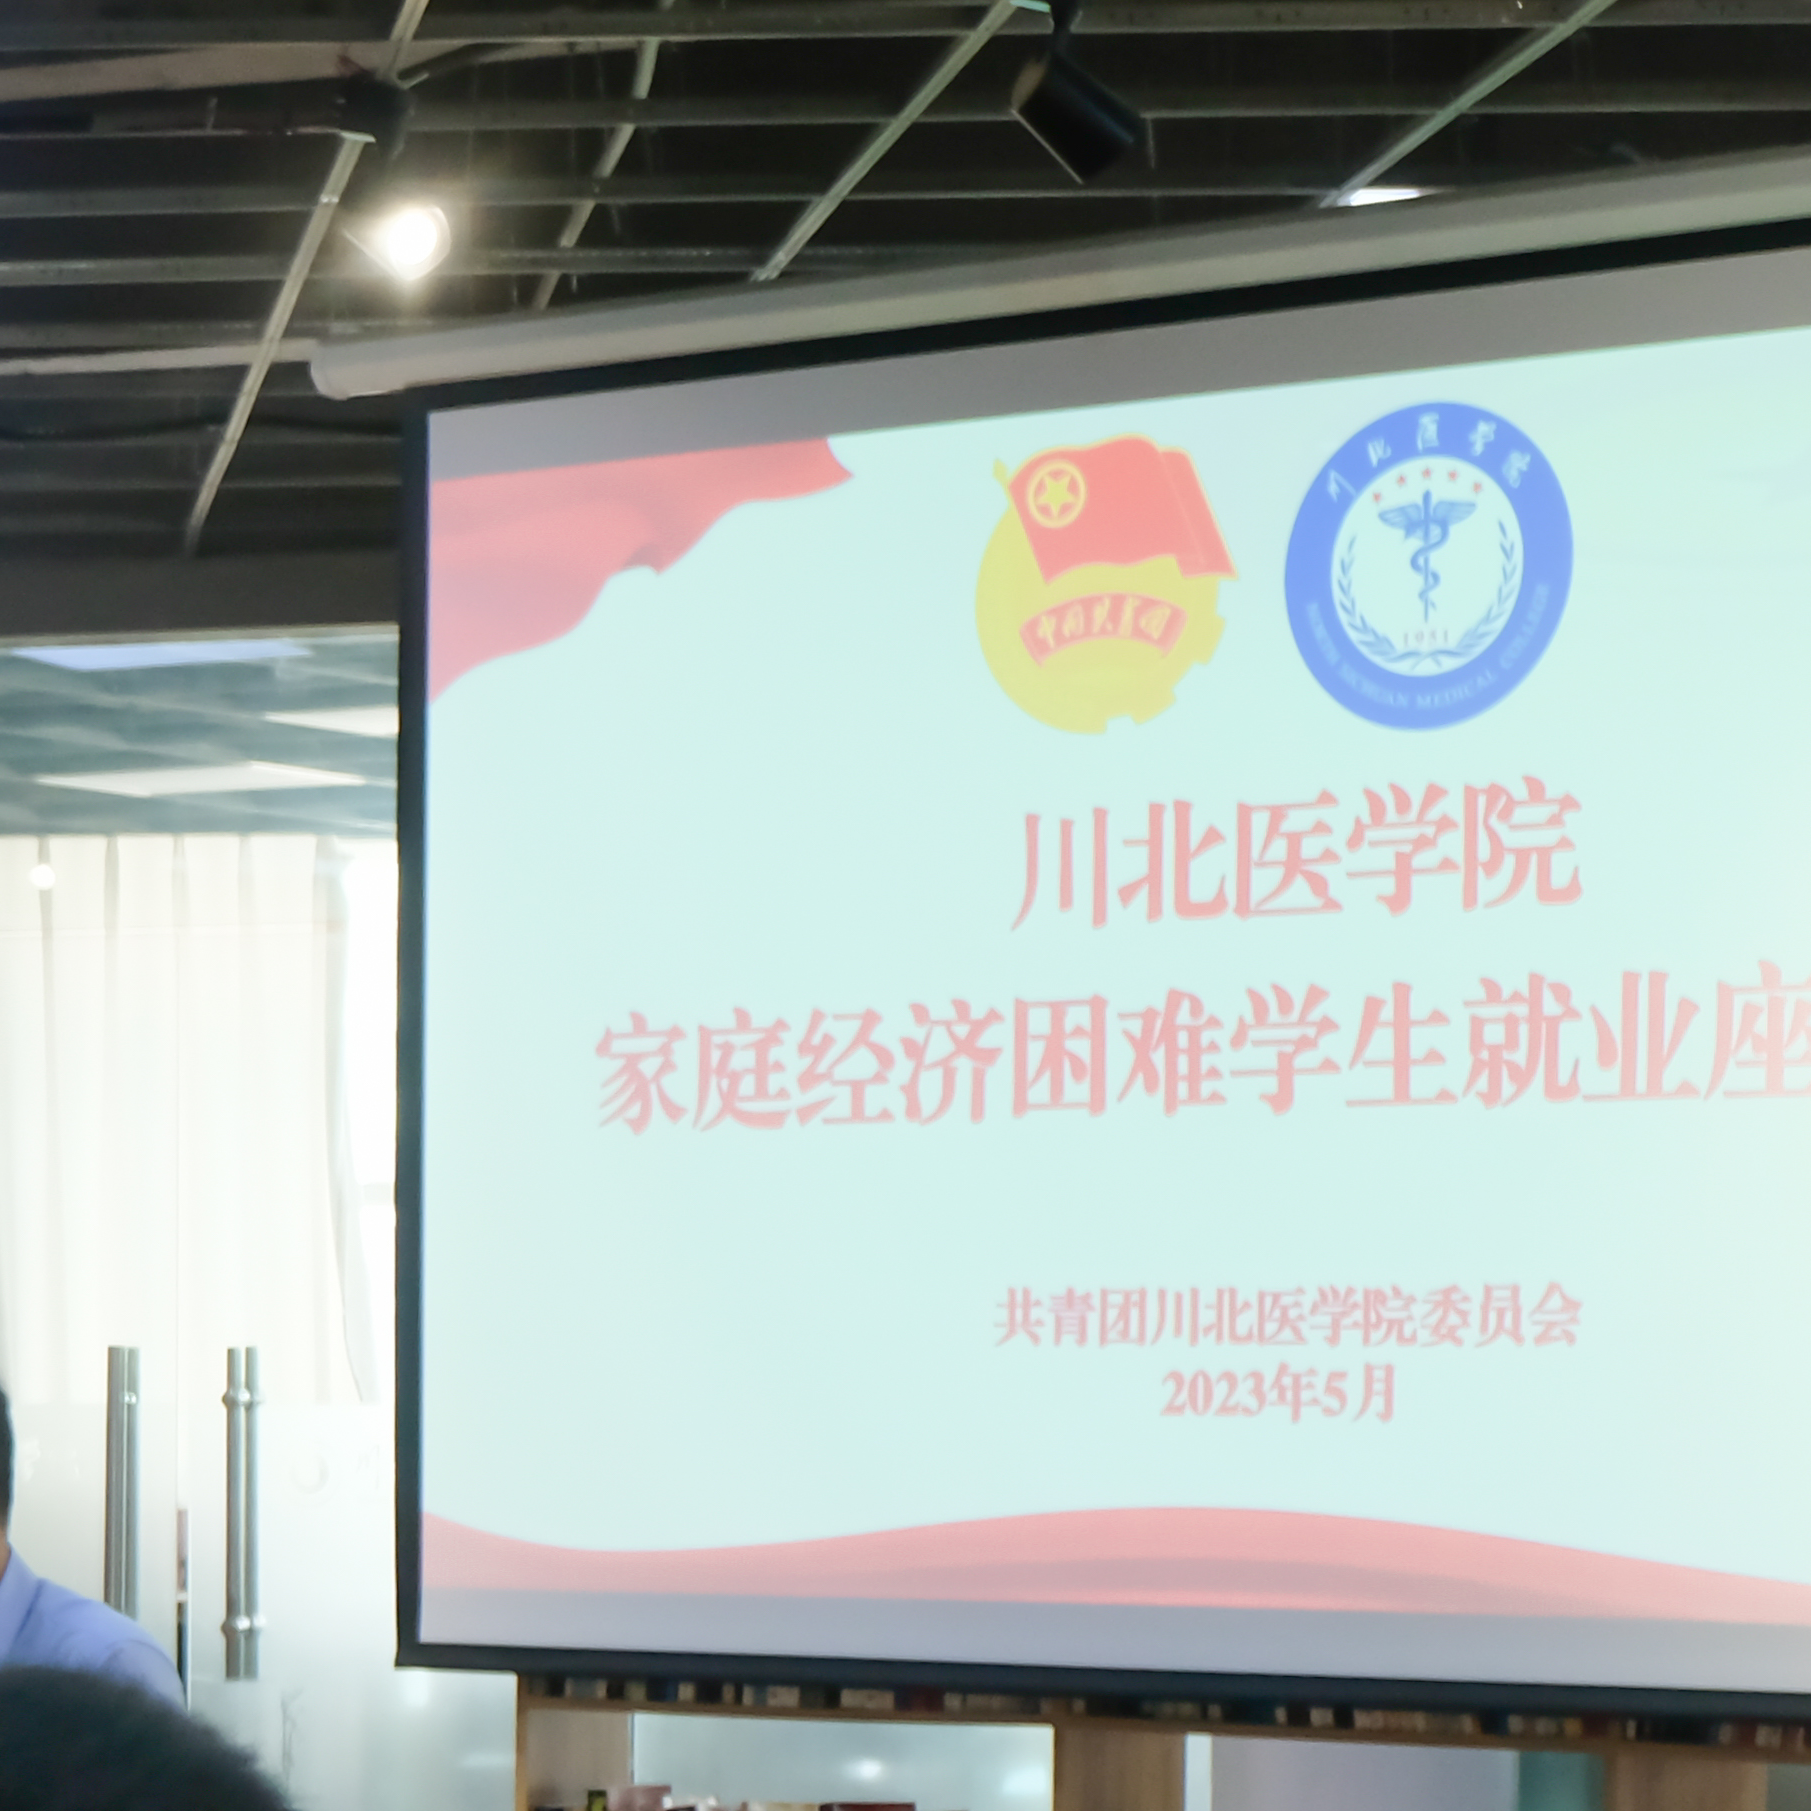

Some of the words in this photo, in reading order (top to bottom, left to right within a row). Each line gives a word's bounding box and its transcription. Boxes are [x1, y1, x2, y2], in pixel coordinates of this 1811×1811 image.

[1010, 774, 1584, 931] 川北医学院
[592, 958, 1811, 1135] 家庭经济困难学生就业座
[993, 1281, 1582, 1348] 共青团川北医学院委员会
[1160, 1361, 1396, 1424] 2023年5月
